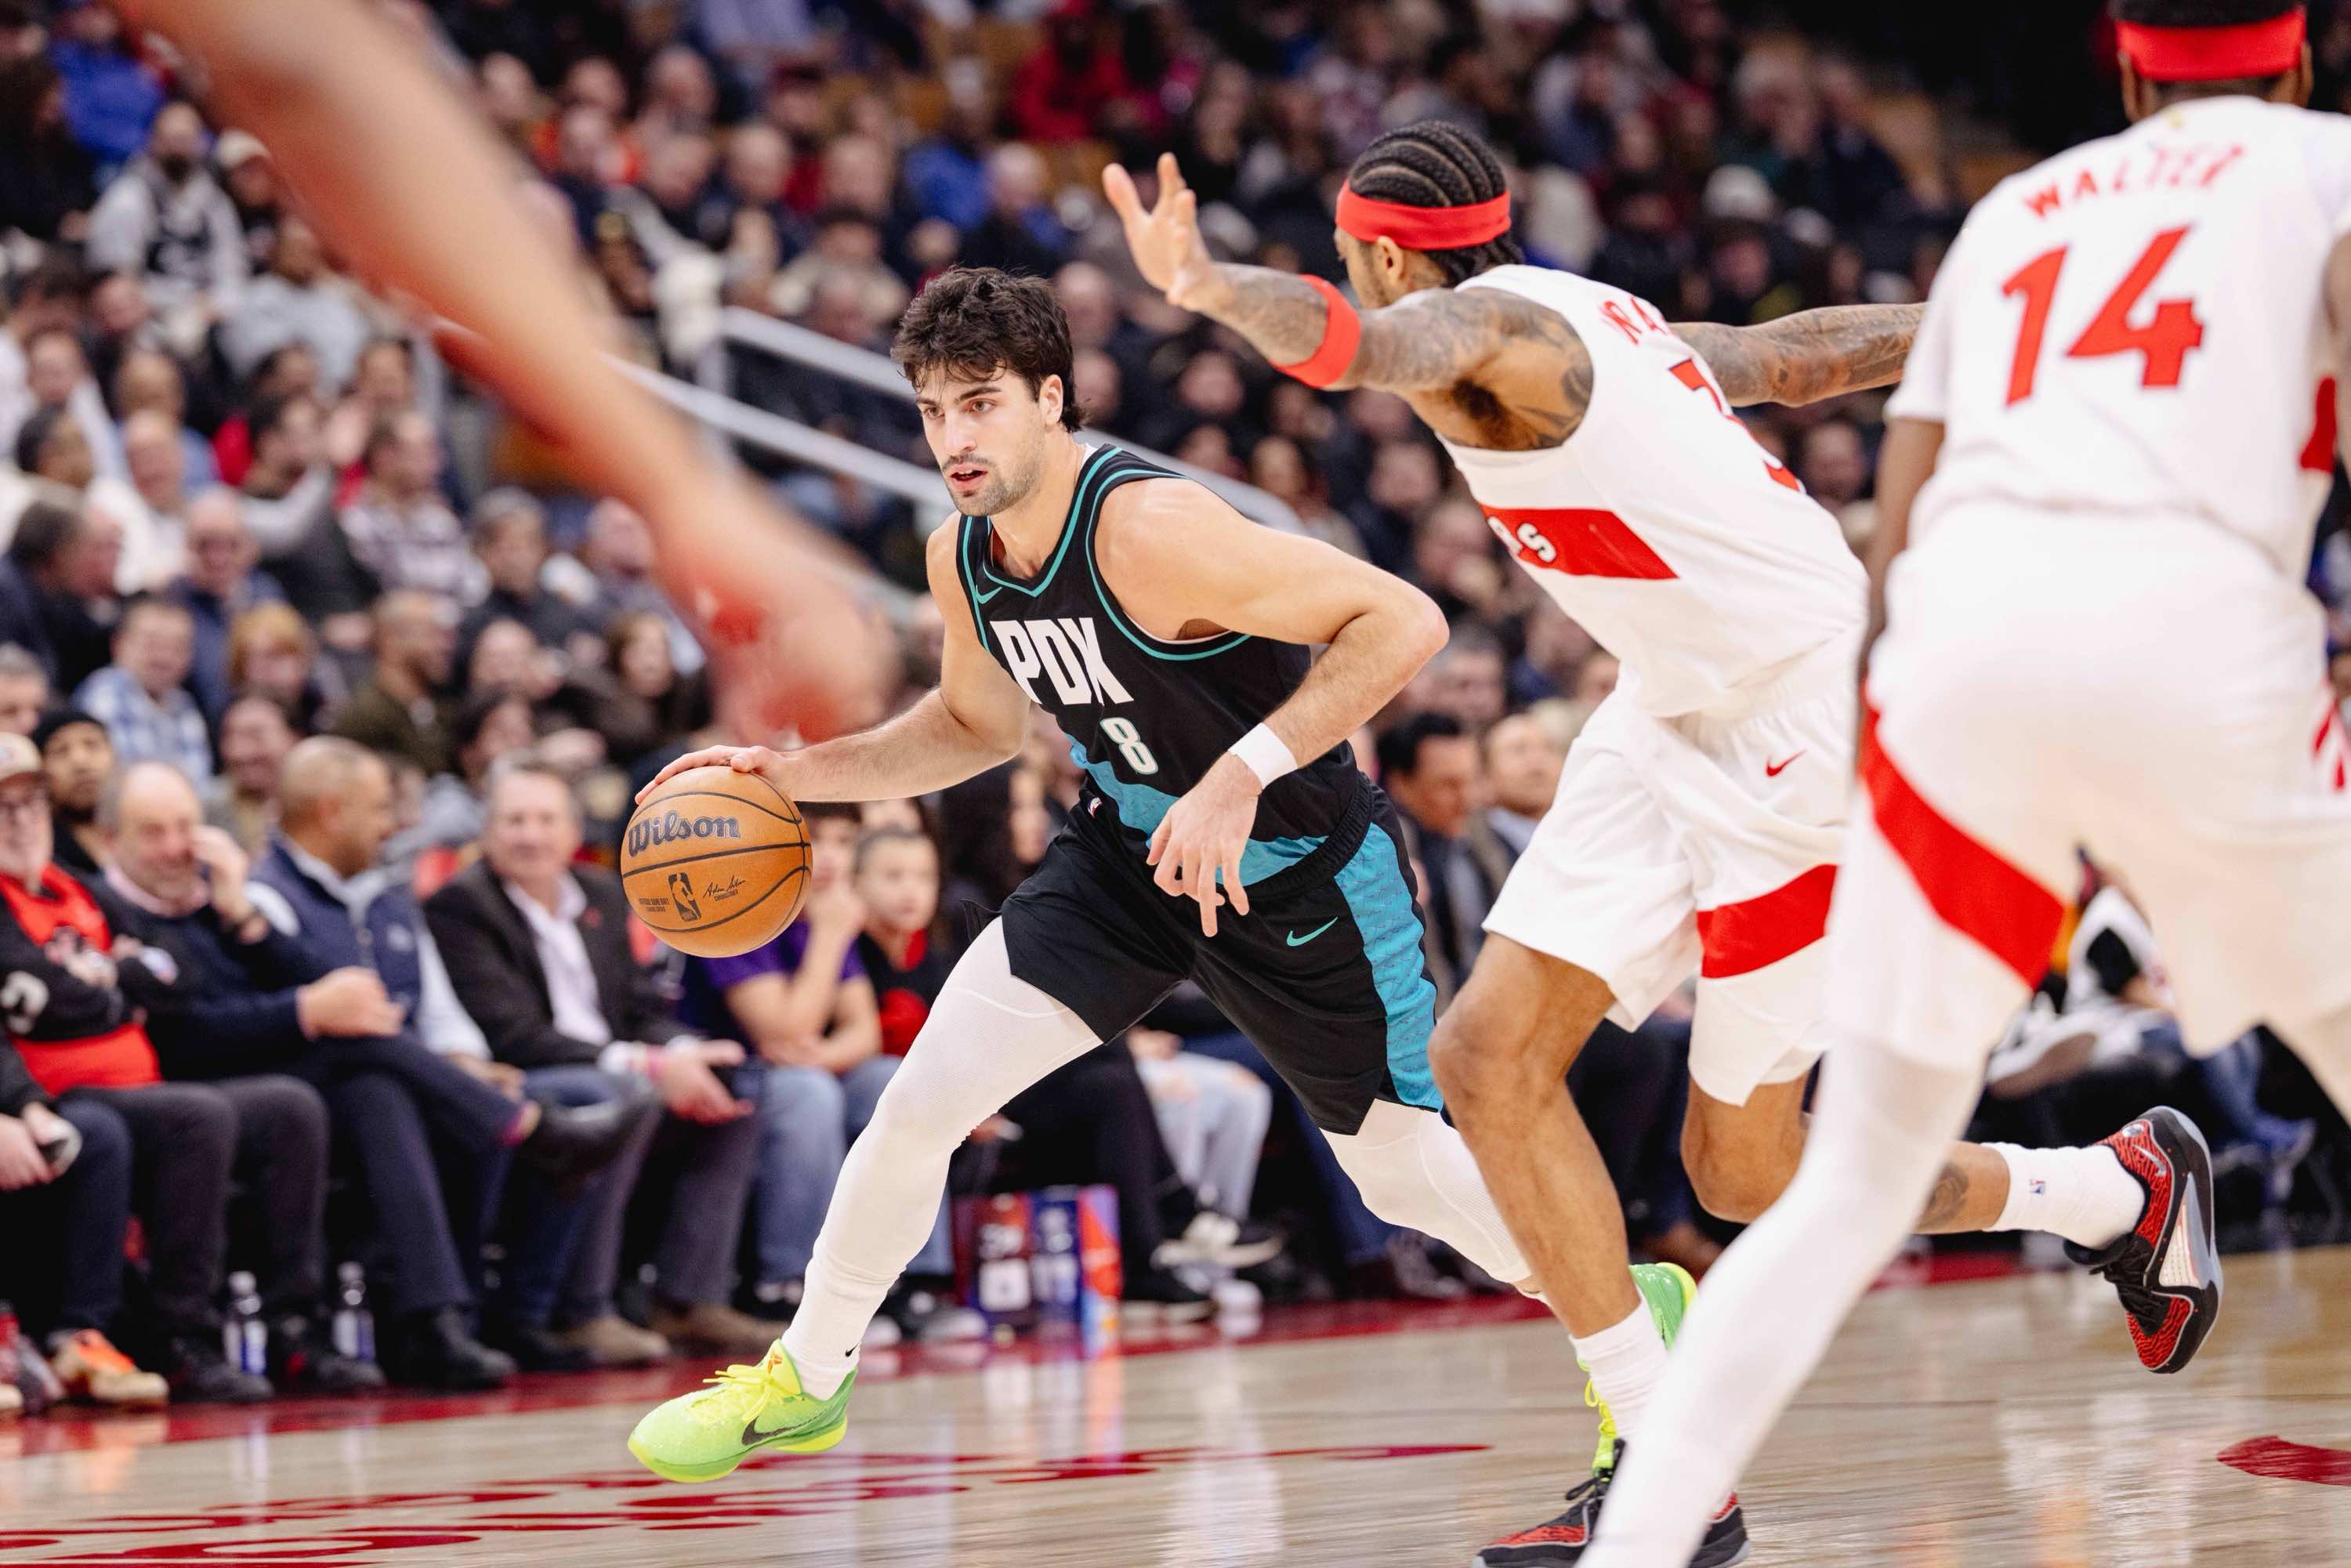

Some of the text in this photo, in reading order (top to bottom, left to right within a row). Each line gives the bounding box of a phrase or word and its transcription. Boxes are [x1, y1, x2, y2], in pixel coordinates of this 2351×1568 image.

[2001, 222, 2204, 409] 14
[990, 617, 1134, 706] PDX
[1100, 717, 1158, 774] 8
[628, 809, 741, 857] Wilson
